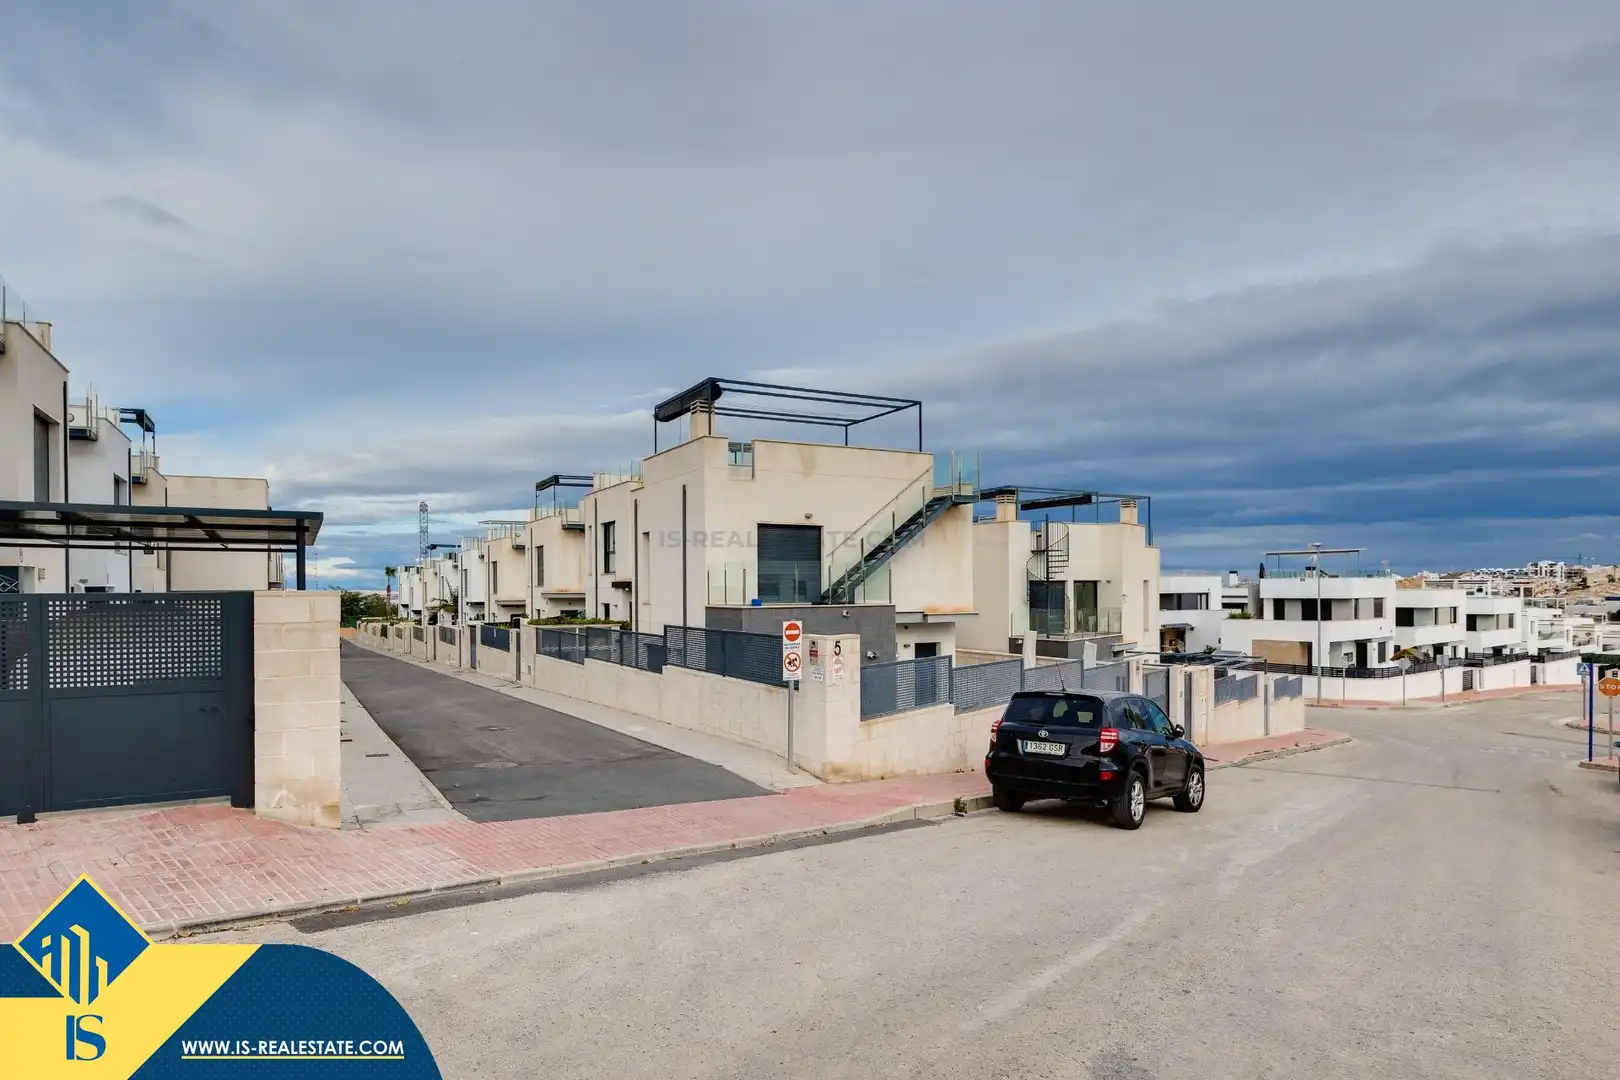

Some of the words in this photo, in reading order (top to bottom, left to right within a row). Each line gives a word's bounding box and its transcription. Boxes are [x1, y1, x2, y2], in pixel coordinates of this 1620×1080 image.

[834, 640, 841, 656] 5
[1029, 742, 1047, 751] 1362
[1049, 743, 1063, 752] GSR
